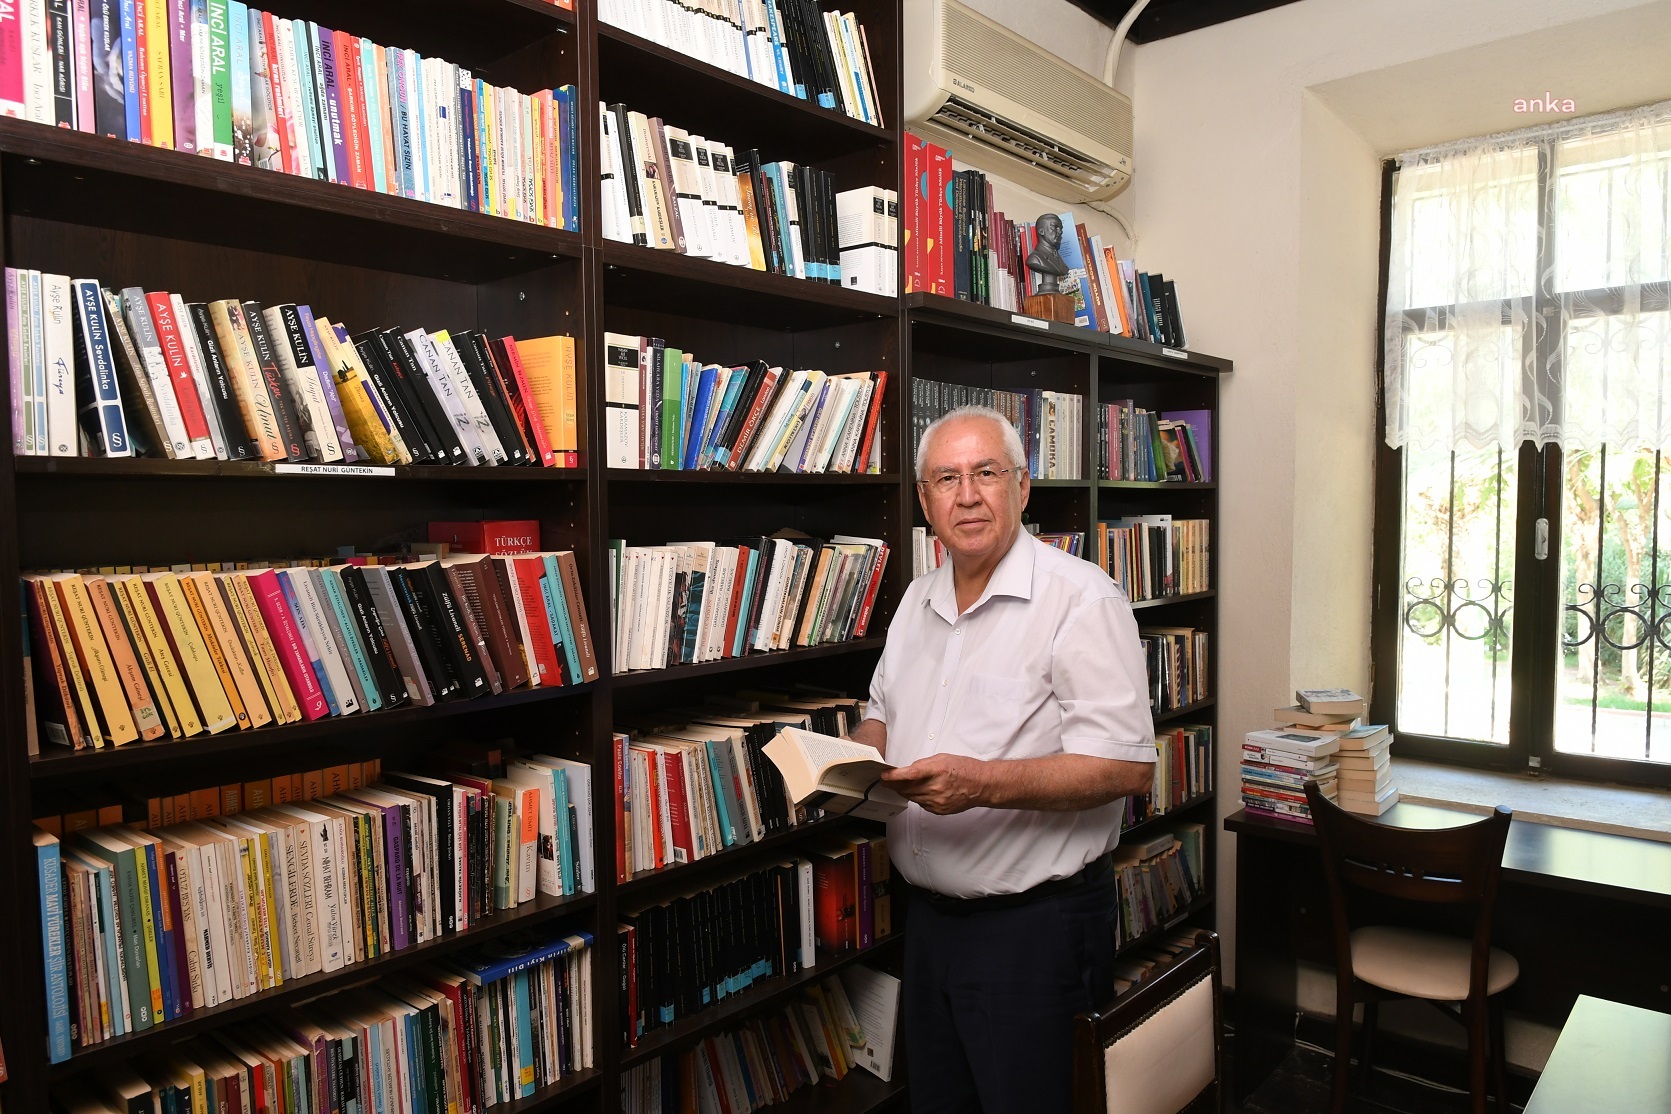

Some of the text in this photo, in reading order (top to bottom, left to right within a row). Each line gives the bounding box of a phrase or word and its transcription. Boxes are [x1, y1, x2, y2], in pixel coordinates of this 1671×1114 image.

[210, 2, 228, 35] İNCİ
[212, 35, 227, 75] ARAL
[322, 41, 343, 145] İNCİ ARAL unutmak
[401, 111, 408, 121] BU
[402, 124, 410, 148] HAYAT
[85, 289, 110, 390] AYŞE KULİN Sevdalinka
[156, 303, 183, 367] AYŞE KULİN
[249, 311, 263, 332] AYŞE
[257, 335, 271, 361] KULİN
[285, 309, 309, 364] AYŞE KULİN
[418, 334, 453, 397] CANAN TAN
[460, 375, 474, 399] TAN
[301, 465, 373, 475] REŞAT NURİ GÜNTEKİN
[495, 536, 532, 548] TÜRKÇE
[875, 546, 886, 573] DEVLET
[457, 633, 472, 662] SERENAD
[46, 895, 62, 914] MAVİ
[47, 915, 63, 957] YÜREKLER
